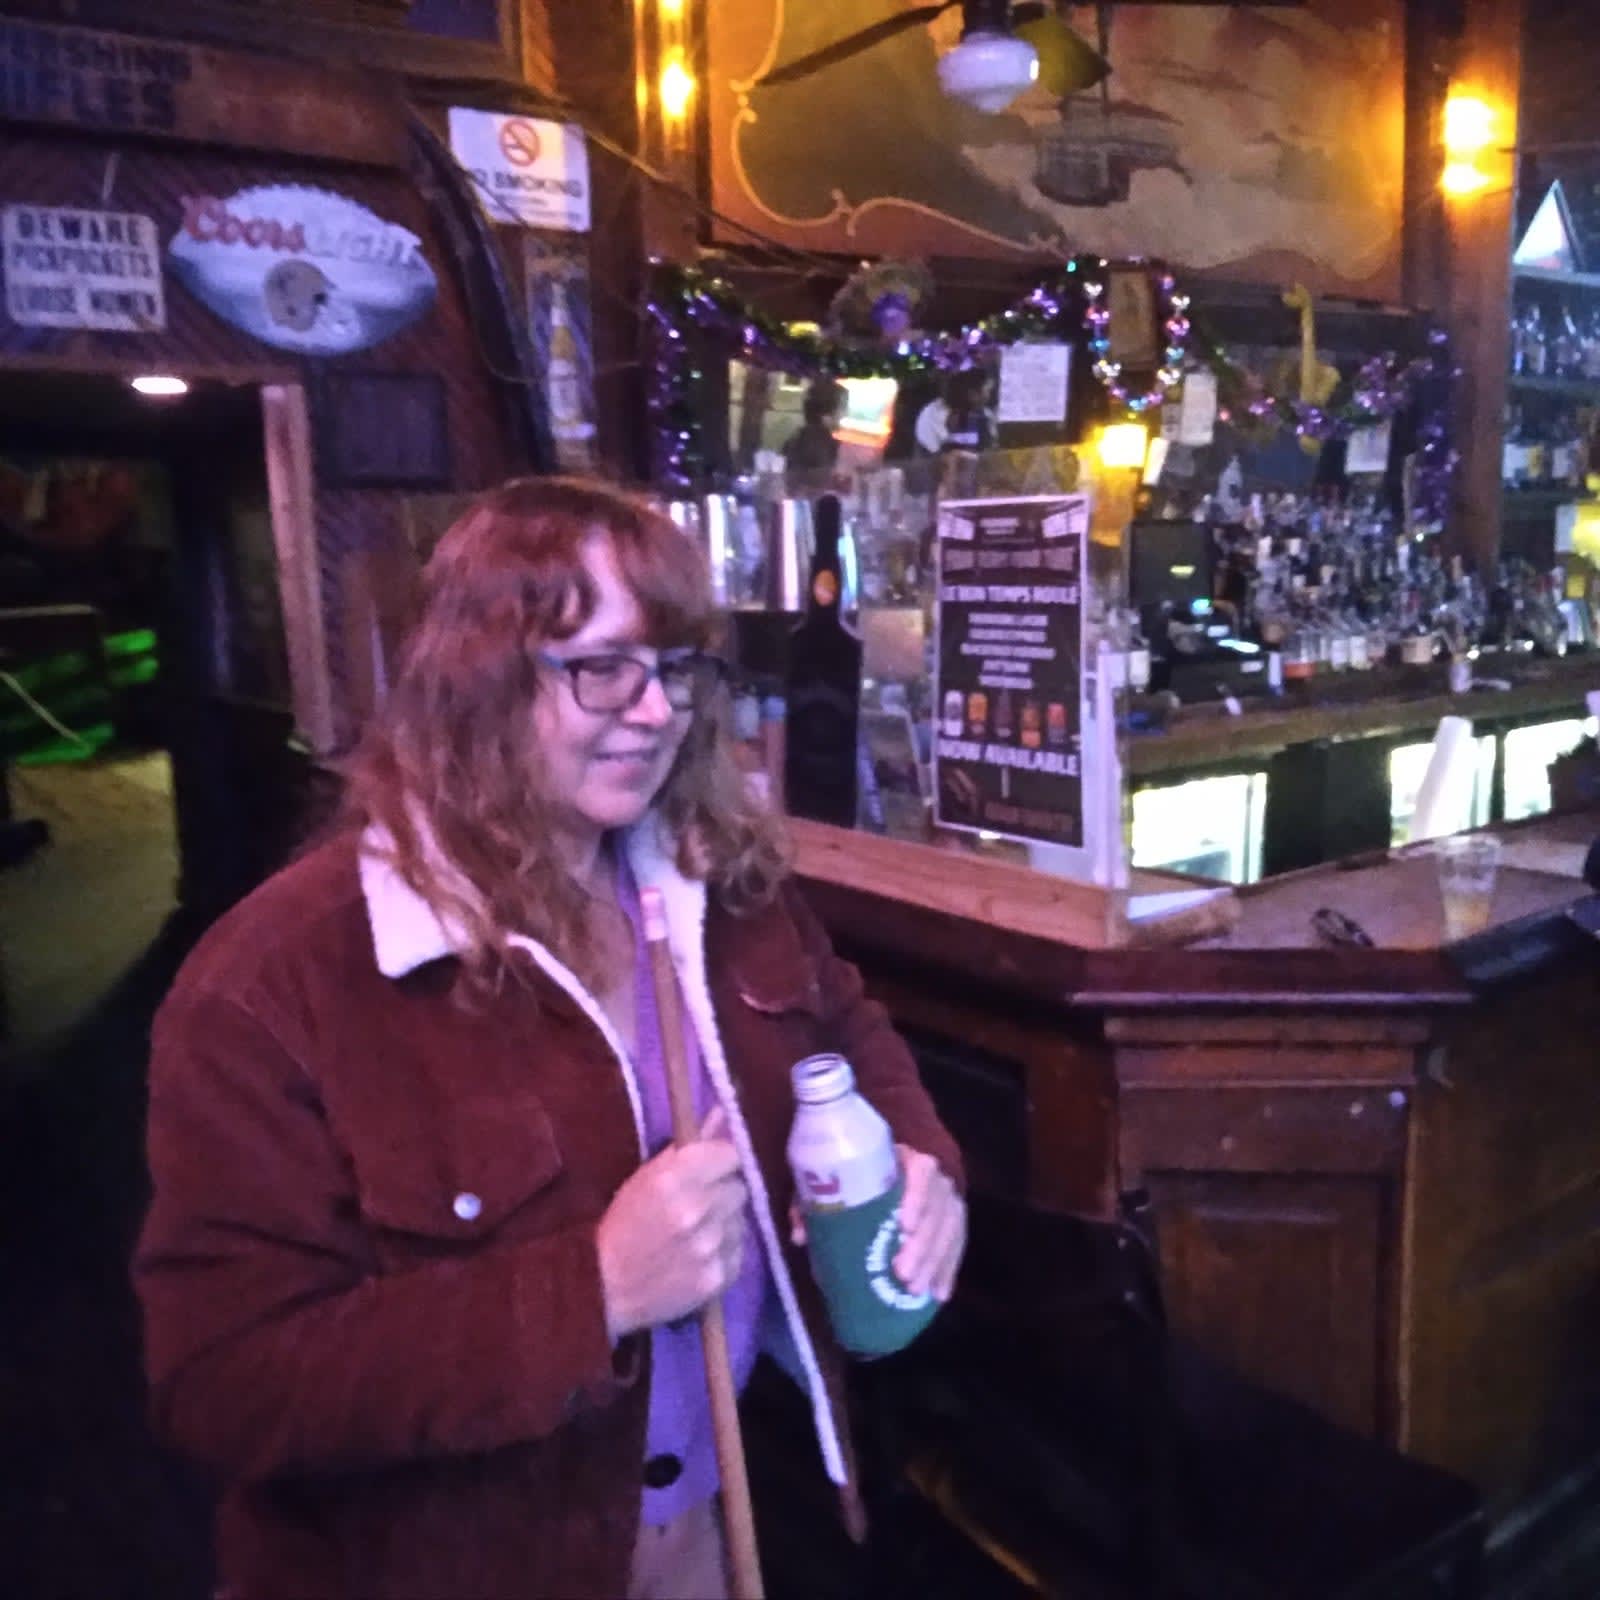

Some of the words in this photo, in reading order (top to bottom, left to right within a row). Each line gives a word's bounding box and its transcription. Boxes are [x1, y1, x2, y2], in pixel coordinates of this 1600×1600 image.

[495, 171, 582, 198] SMOKING
[17, 212, 140, 246] BEWARE
[181, 195, 305, 252] Coors
[11, 242, 154, 280] PICKPOCKETS
[937, 738, 982, 761] NOW
[984, 744, 1080, 777] AVAILABLE
